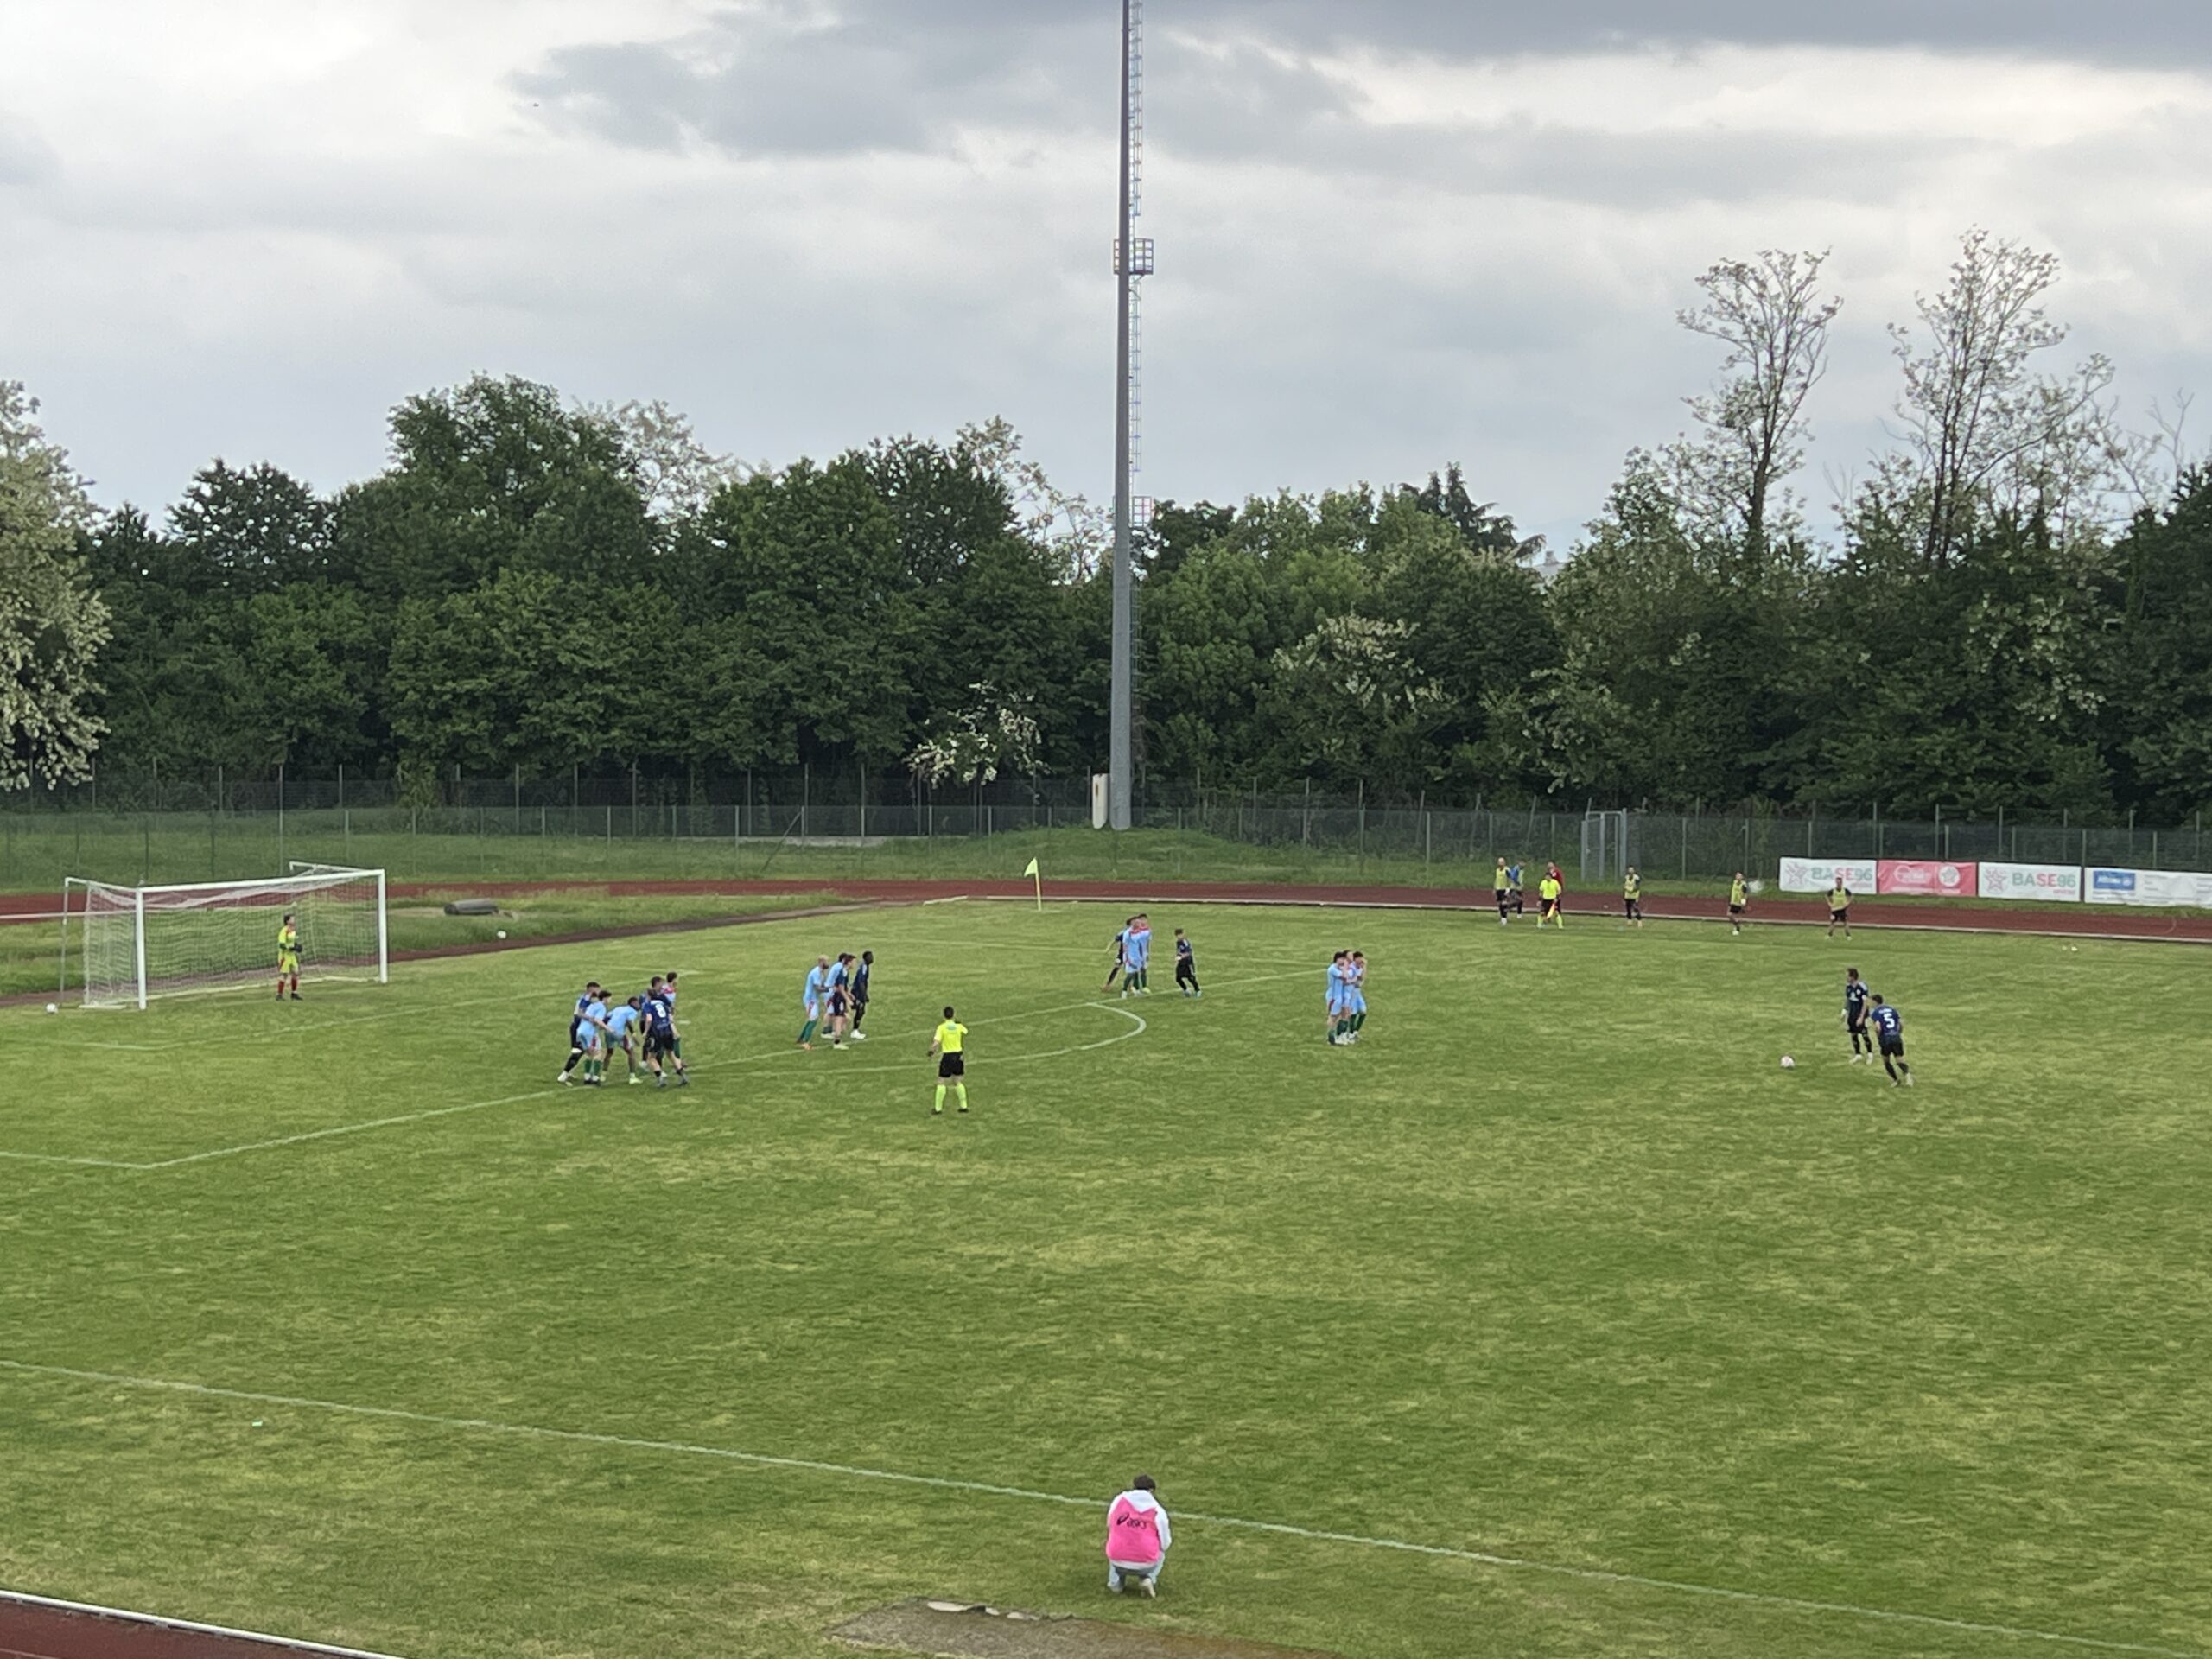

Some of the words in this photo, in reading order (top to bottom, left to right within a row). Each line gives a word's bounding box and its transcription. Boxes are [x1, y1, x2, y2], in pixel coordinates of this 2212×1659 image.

[1810, 867, 1873, 881] BASE96
[2012, 872, 2077, 888] BASE96
[1883, 1013, 1895, 1028] 5
